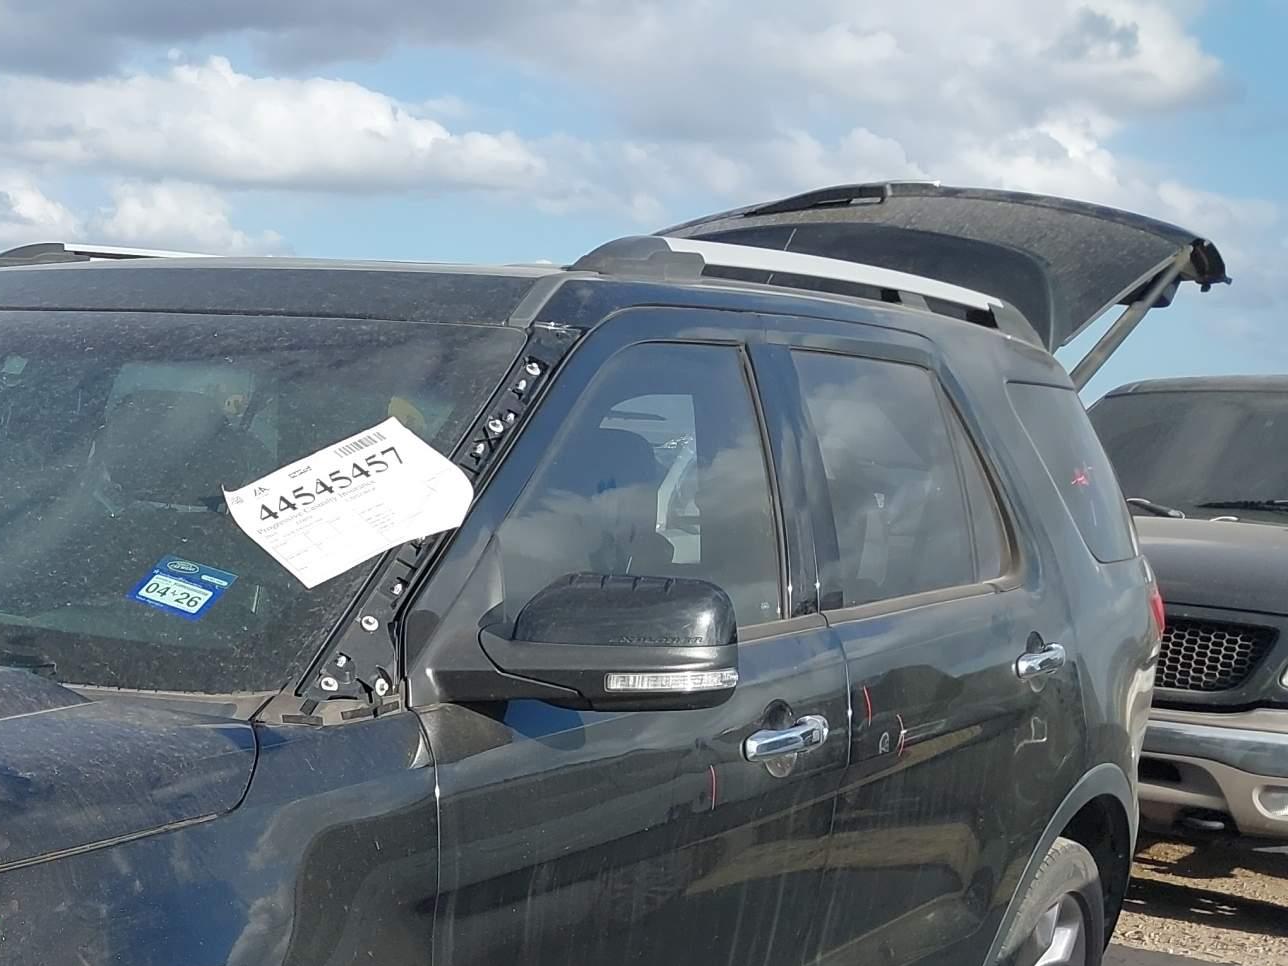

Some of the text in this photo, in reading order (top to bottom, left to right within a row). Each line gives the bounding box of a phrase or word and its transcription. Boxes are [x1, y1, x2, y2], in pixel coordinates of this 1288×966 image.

[259, 446, 404, 521] 44545457
[144, 581, 170, 598] 04
[173, 591, 202, 609] 26
